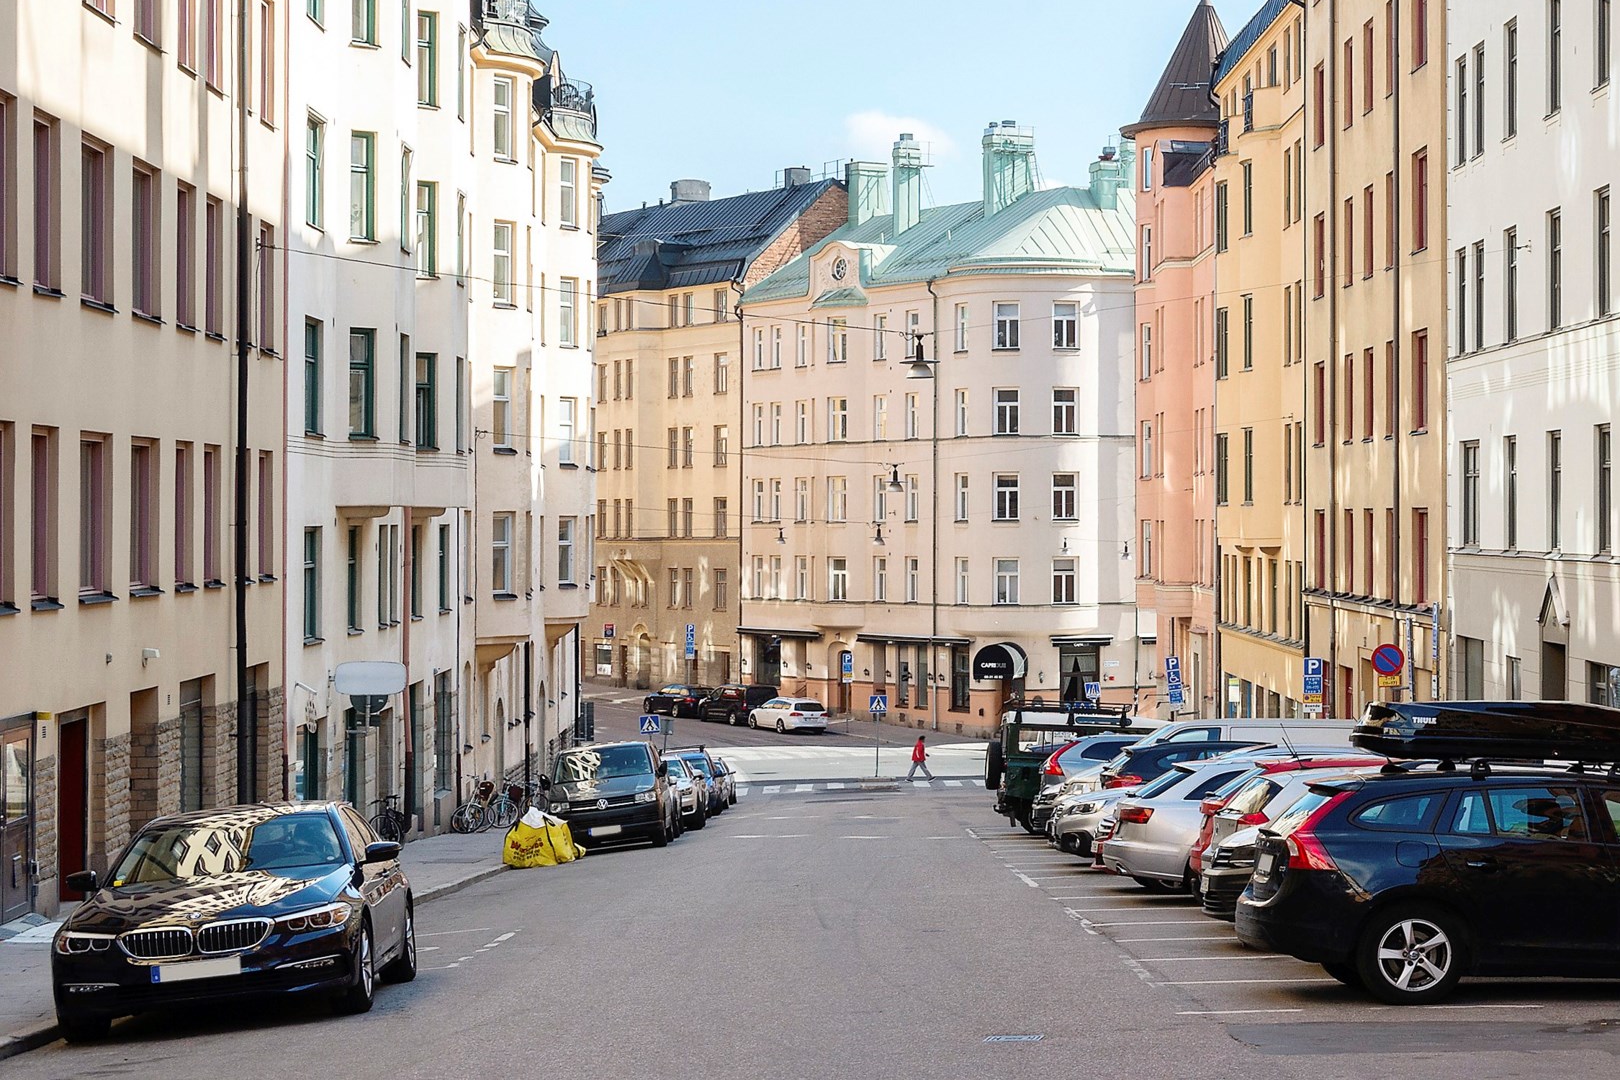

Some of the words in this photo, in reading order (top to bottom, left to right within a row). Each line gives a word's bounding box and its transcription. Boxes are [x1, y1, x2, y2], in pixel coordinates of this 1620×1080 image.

[1169, 659, 1177, 670] P
[1308, 659, 1319, 675] P
[1411, 716, 1437, 724] THULE
